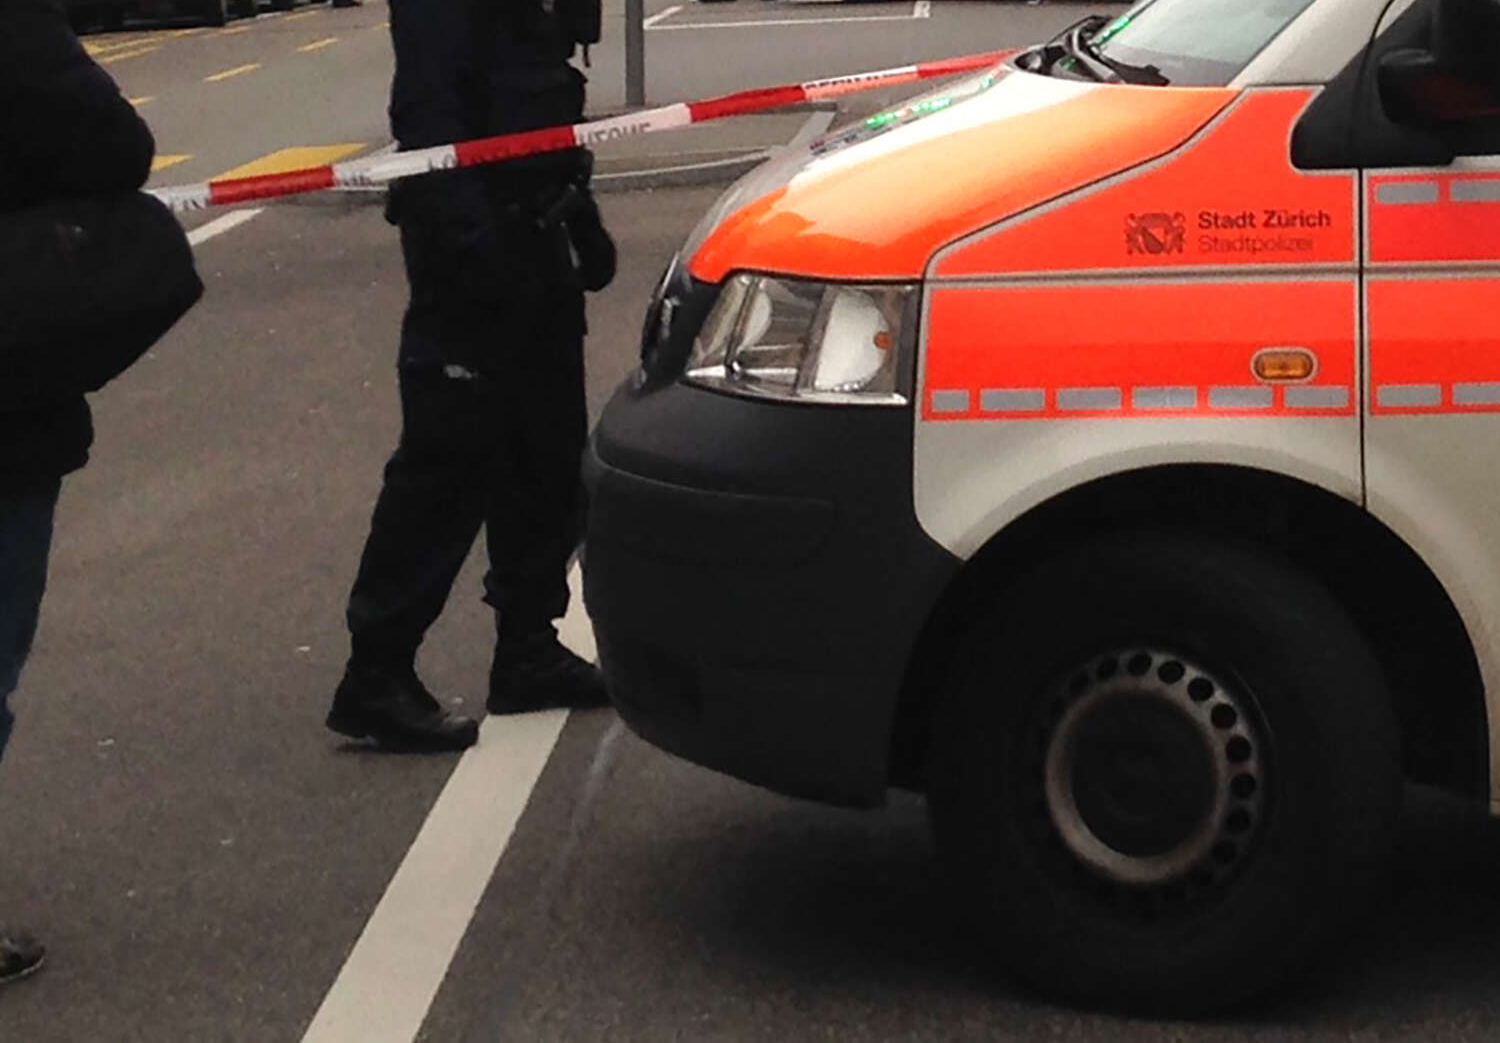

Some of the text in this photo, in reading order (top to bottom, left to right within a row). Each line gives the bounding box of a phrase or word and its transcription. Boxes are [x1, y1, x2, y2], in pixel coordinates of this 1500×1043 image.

[1198, 209, 1331, 229] Stadt Zürich
[1198, 234, 1314, 254] Stadtpolizei
